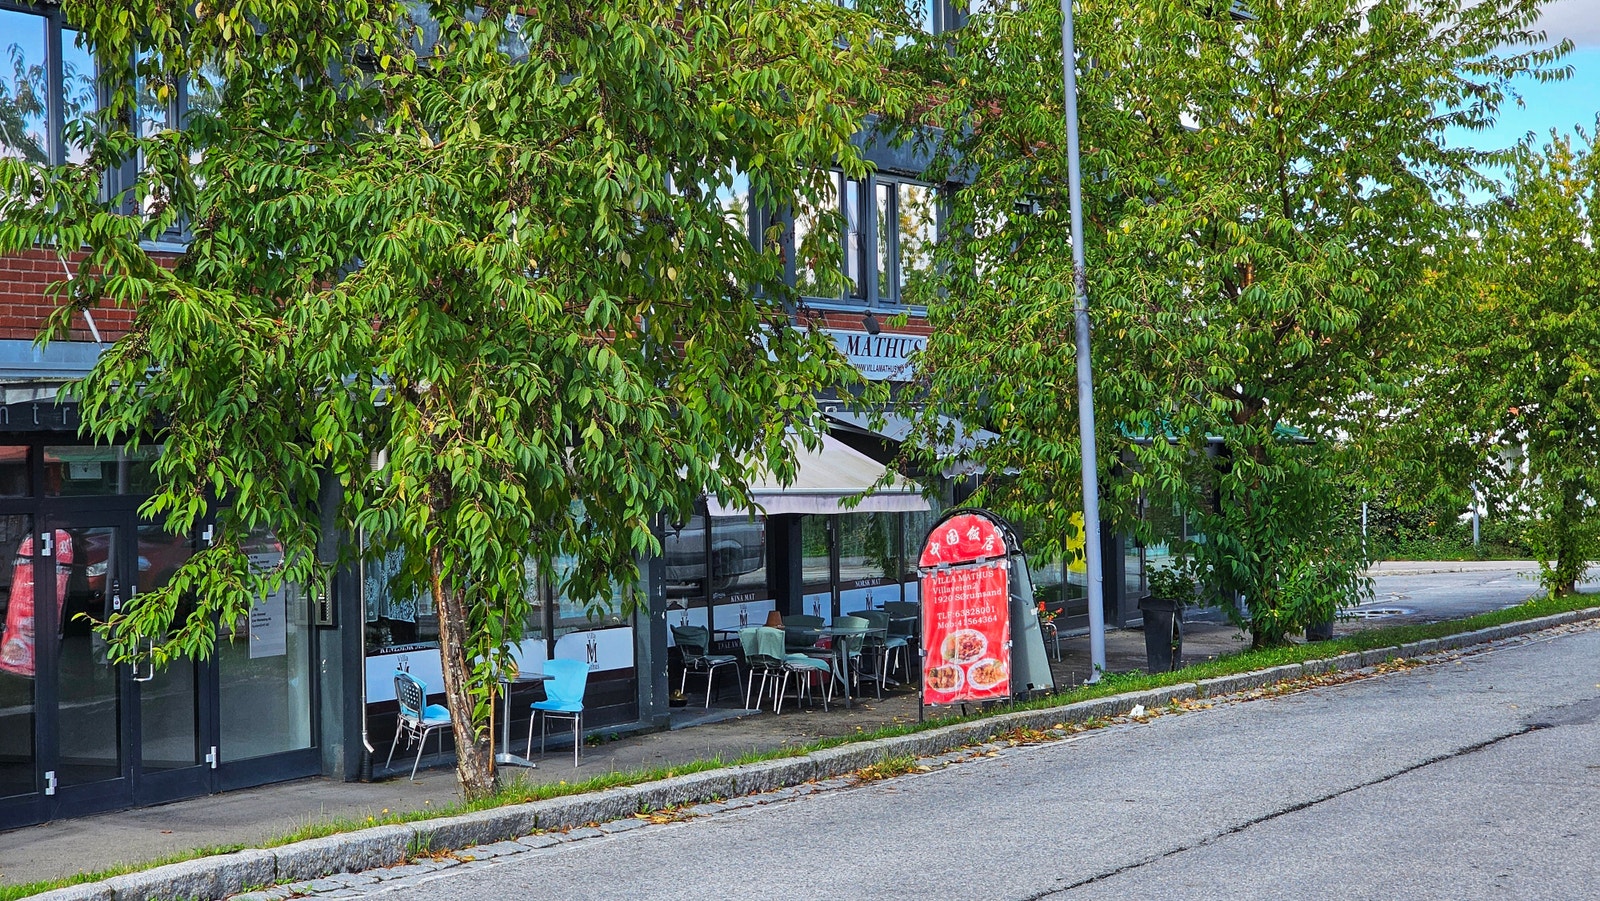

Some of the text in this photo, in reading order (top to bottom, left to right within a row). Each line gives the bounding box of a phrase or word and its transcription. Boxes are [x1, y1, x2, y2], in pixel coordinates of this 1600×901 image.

[932, 570, 994, 586] VILLA MATHUS
[730, 592, 756, 603] KINA MAT
[933, 595, 953, 604] 1920
